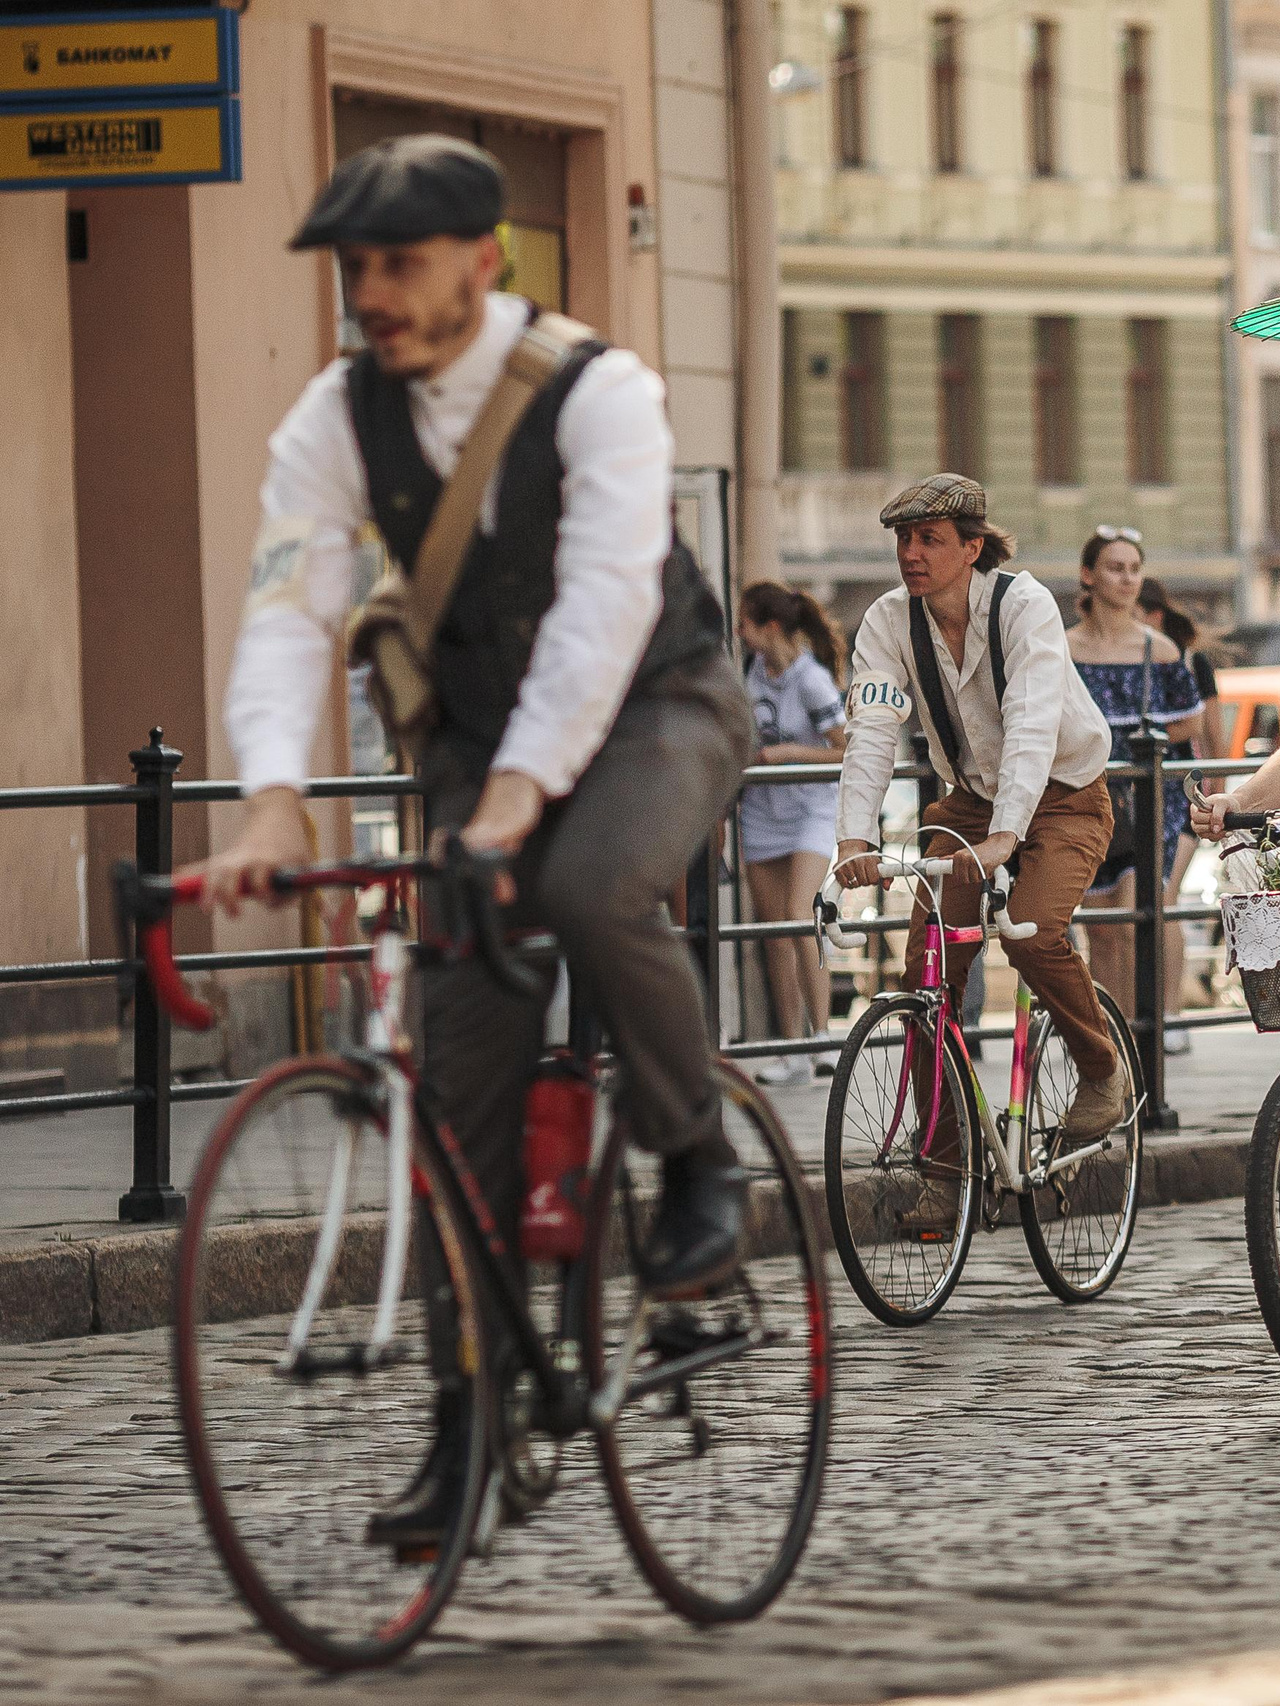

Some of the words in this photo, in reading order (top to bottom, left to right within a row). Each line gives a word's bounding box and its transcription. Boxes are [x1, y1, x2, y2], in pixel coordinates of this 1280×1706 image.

[56, 45, 172, 65] БАНКОМАТ
[66, 138, 138, 154] UNION
[861, 682, 905, 709] 018
